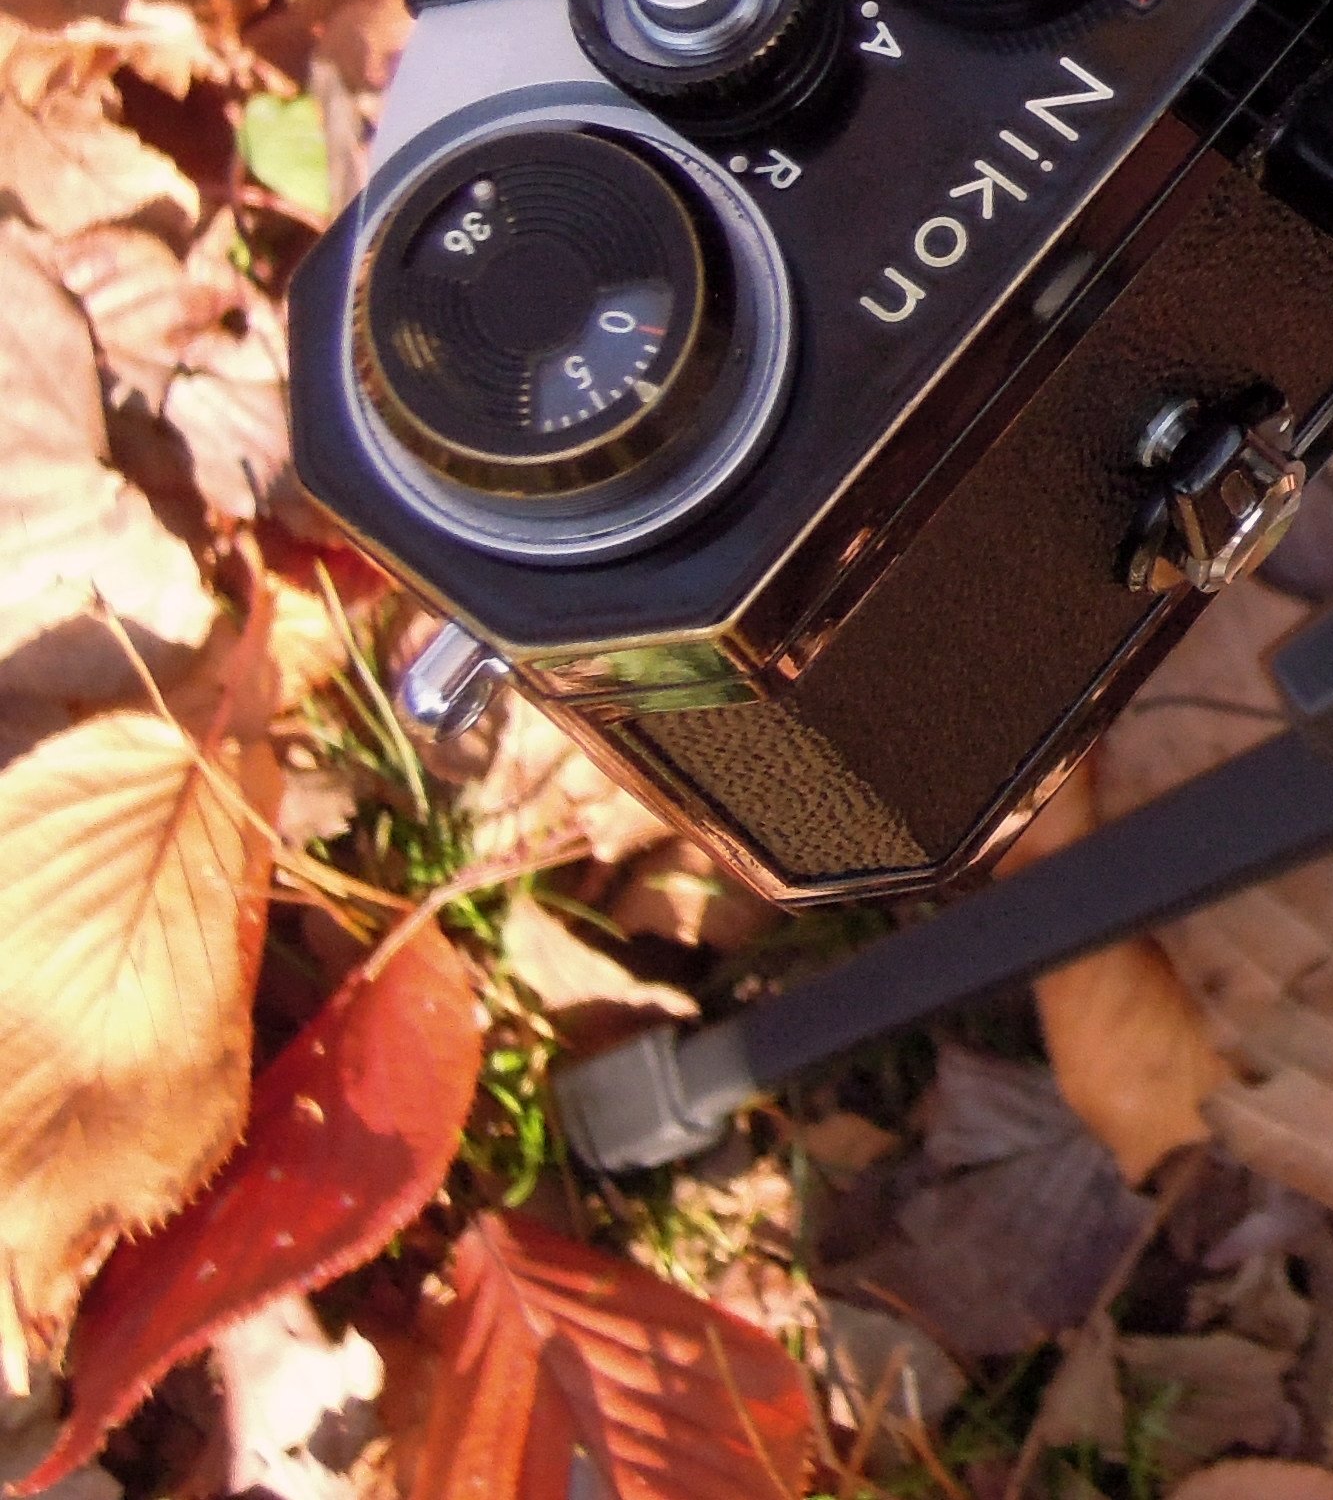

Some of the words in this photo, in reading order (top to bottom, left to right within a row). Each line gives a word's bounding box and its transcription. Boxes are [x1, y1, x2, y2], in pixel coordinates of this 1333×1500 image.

[860, 20, 902, 59] A
[753, 148, 802, 190] R
[859, 56, 1114, 323] Nikon
[442, 211, 492, 255] 36
[599, 310, 636, 334] 0
[563, 355, 593, 390] 5
